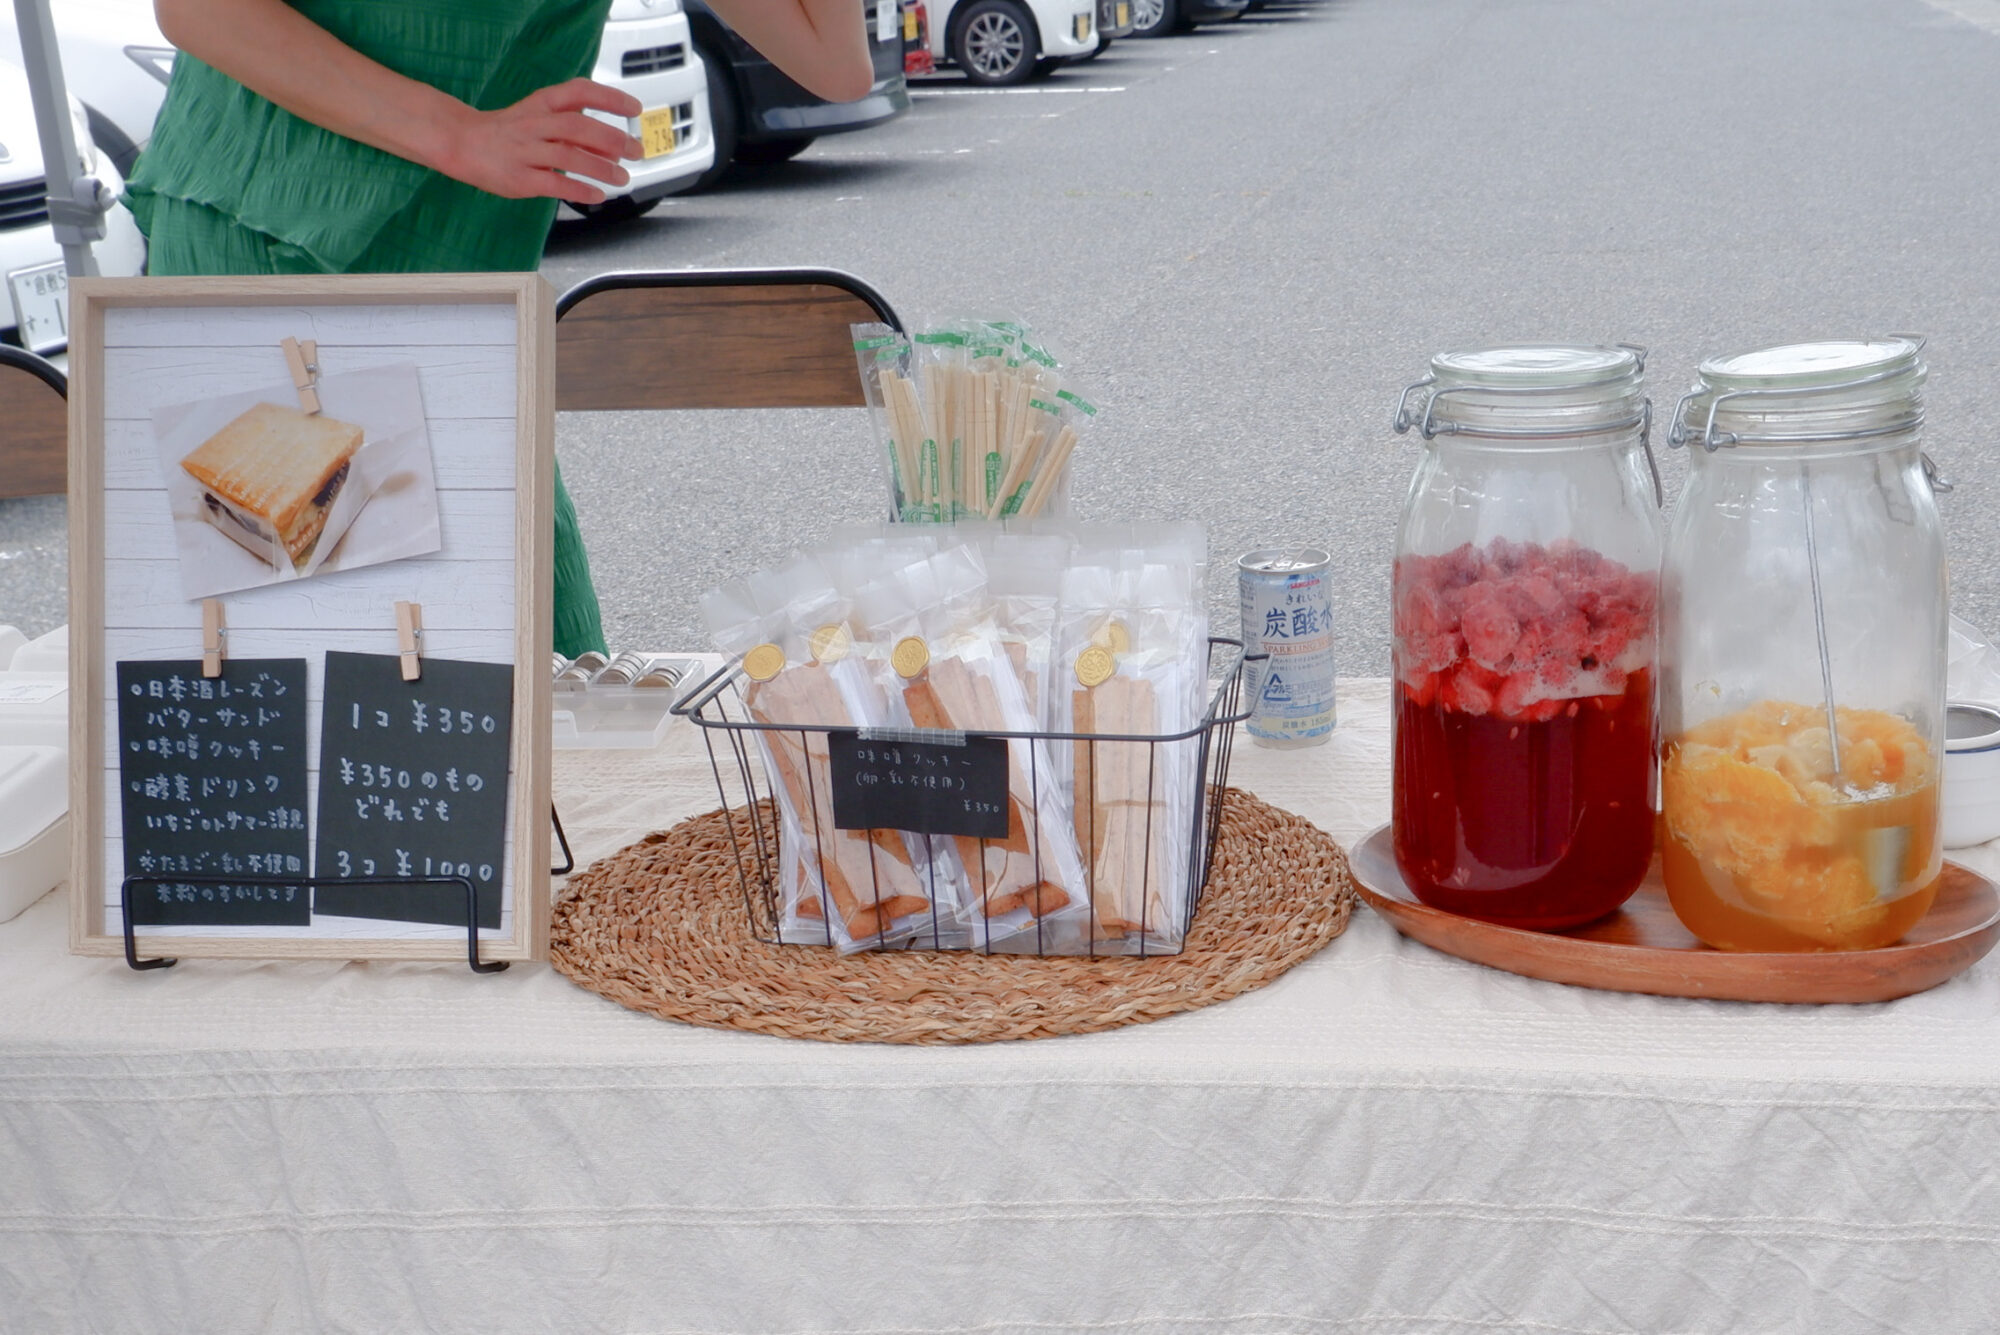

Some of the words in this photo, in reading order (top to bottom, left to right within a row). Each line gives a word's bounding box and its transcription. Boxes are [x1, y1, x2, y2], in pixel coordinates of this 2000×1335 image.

[1263, 600, 1333, 638] 炭酸水
[149, 672, 287, 701] 日本酒レーズン
[147, 706, 281, 729] バターサンド
[355, 794, 450, 822] どれでも
